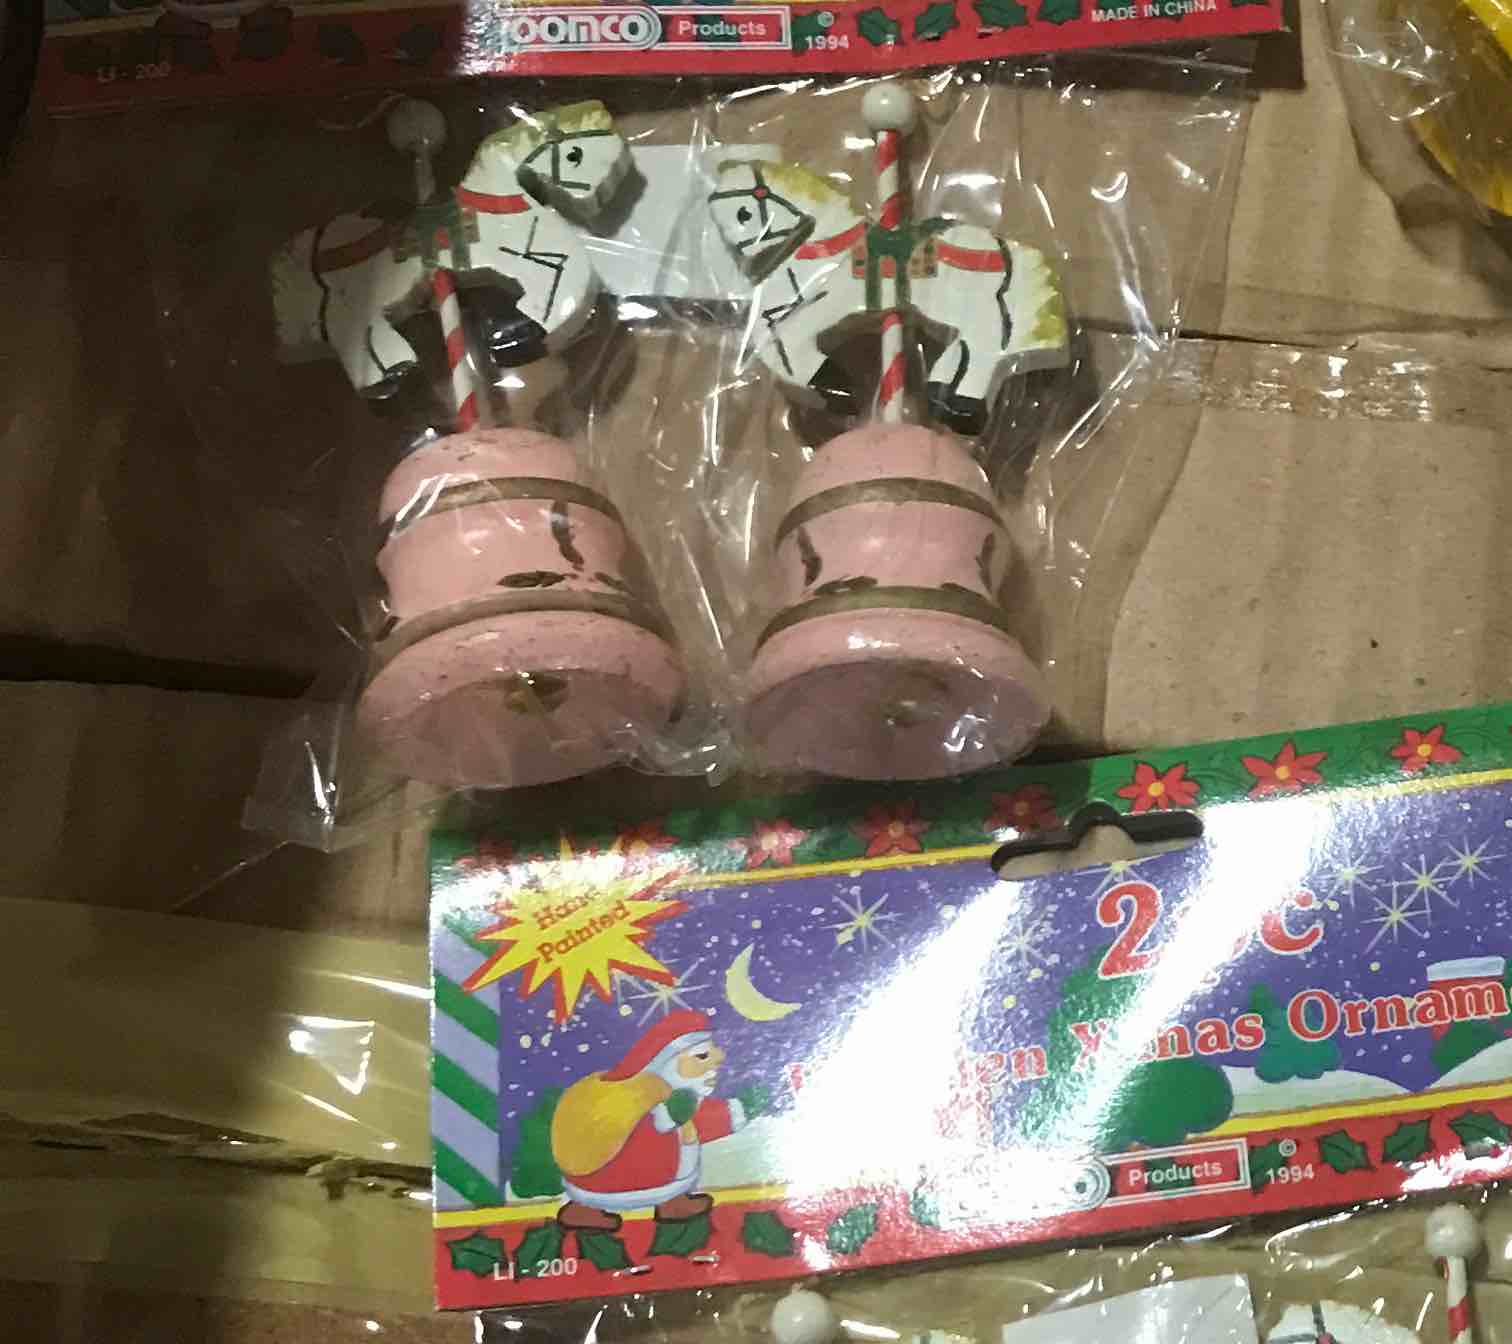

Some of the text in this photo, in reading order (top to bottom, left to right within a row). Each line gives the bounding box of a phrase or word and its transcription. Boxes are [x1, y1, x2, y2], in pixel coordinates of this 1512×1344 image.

[1090, 5, 1138, 23] MADE
[1142, 2, 1160, 18] IN
[503, 13, 768, 44] oomco Products
[805, 33, 850, 50] 1994
[536, 899, 631, 962] Painted
[1098, 880, 1323, 986] 2c
[1128, 1160, 1223, 1188] Products
[1265, 1162, 1315, 1185] 1994
[536, 1257, 579, 1278] 200
